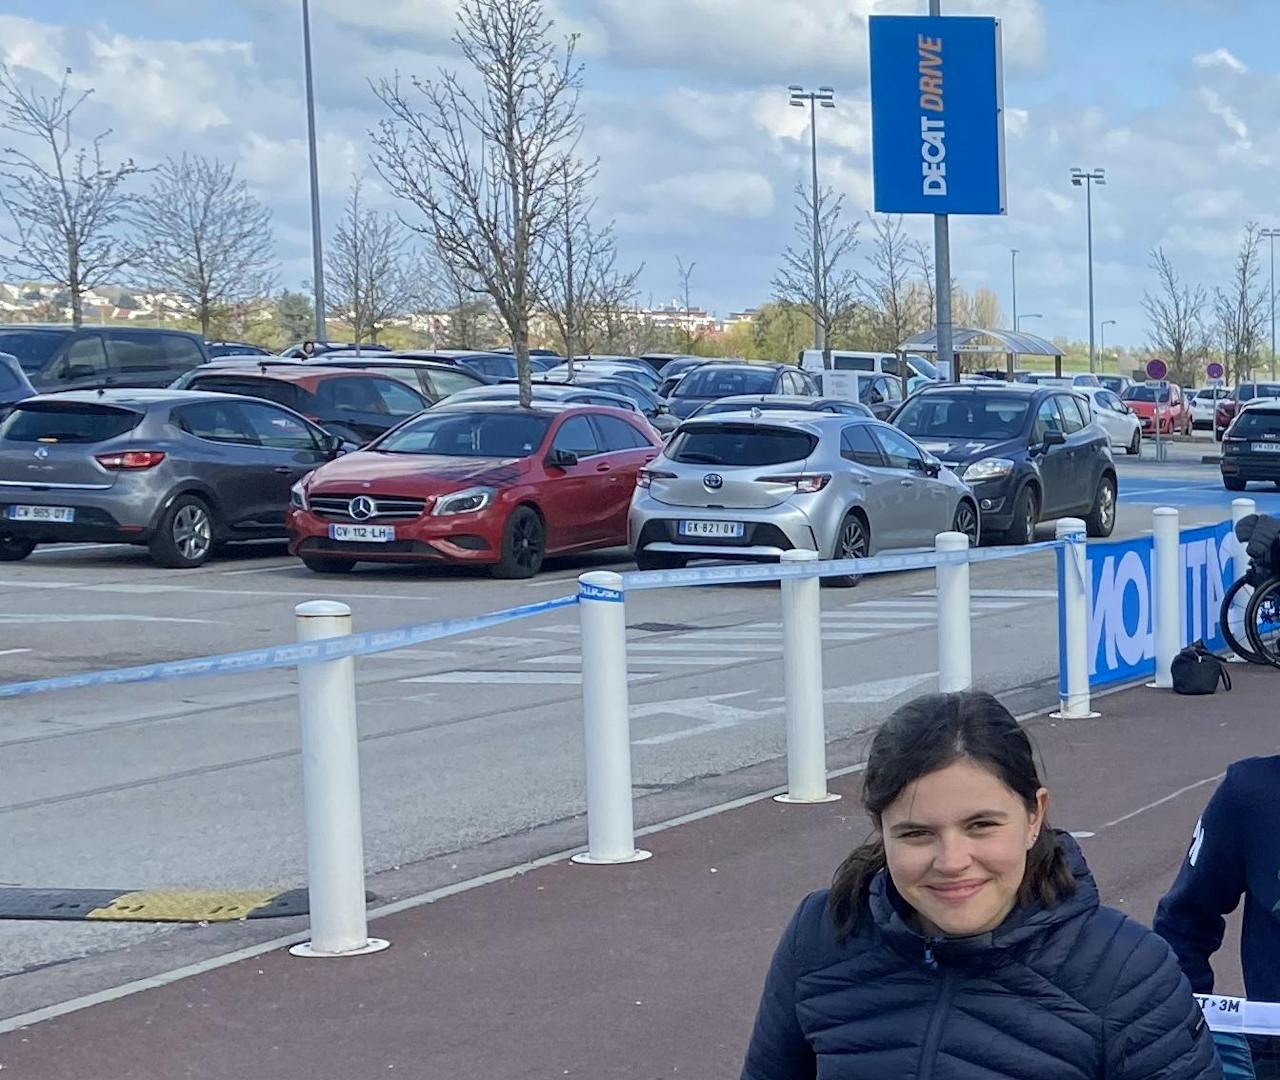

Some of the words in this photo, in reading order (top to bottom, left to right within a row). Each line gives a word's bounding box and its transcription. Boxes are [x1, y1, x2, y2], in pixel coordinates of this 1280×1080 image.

[918, 33, 944, 112] DRIVE
[921, 116, 947, 196] DECAT
[1219, 999, 1240, 1013] 3M
